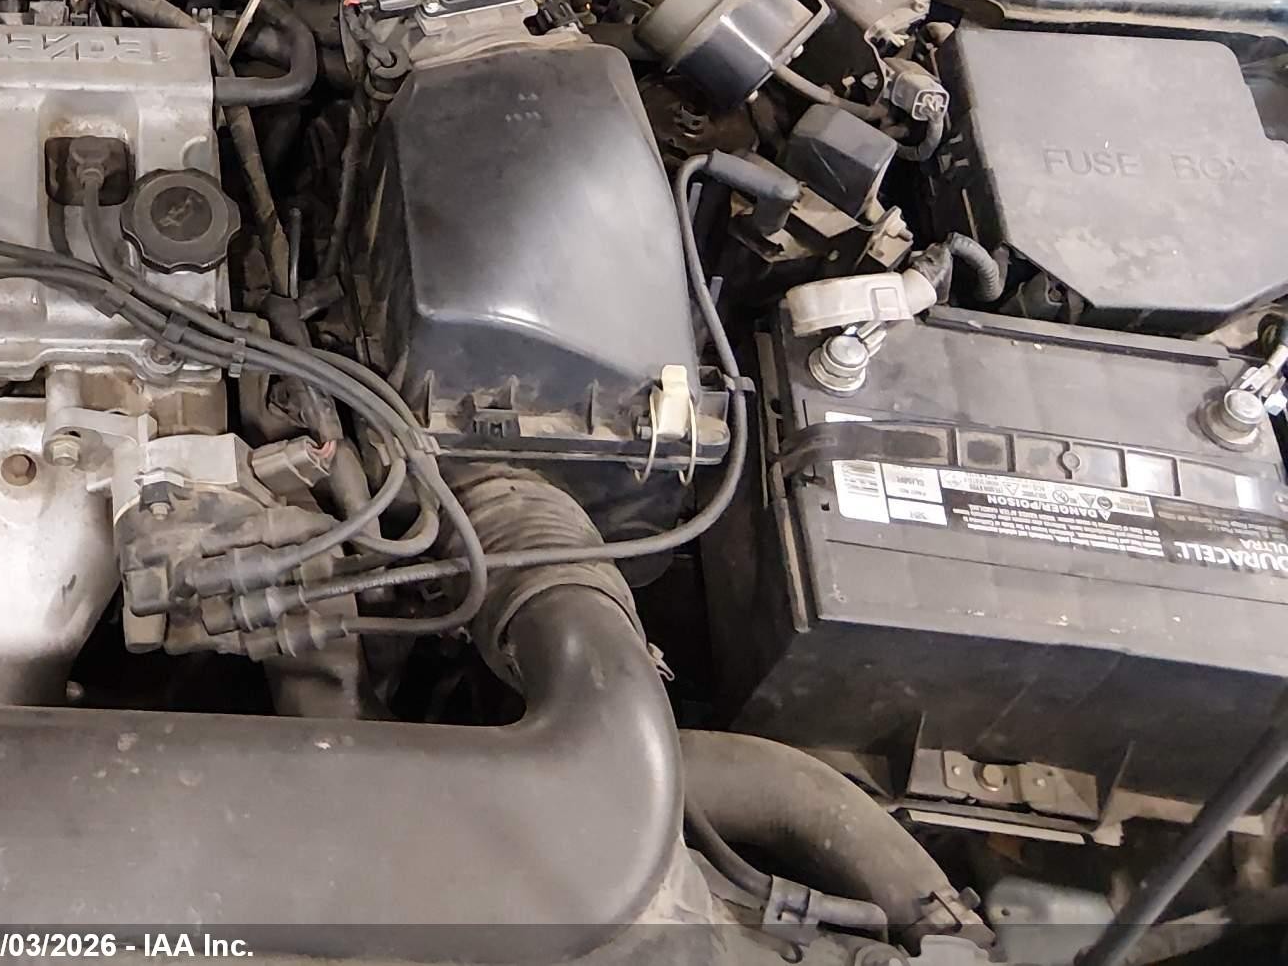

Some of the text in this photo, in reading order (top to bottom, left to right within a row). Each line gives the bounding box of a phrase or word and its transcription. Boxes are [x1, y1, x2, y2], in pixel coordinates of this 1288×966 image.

[1041, 147, 1254, 183] FUSE BOX
[986, 495, 1099, 519] DANGER/POISON
[1174, 541, 1288, 571] DURACELL
[1240, 538, 1288, 553] ULTRA
